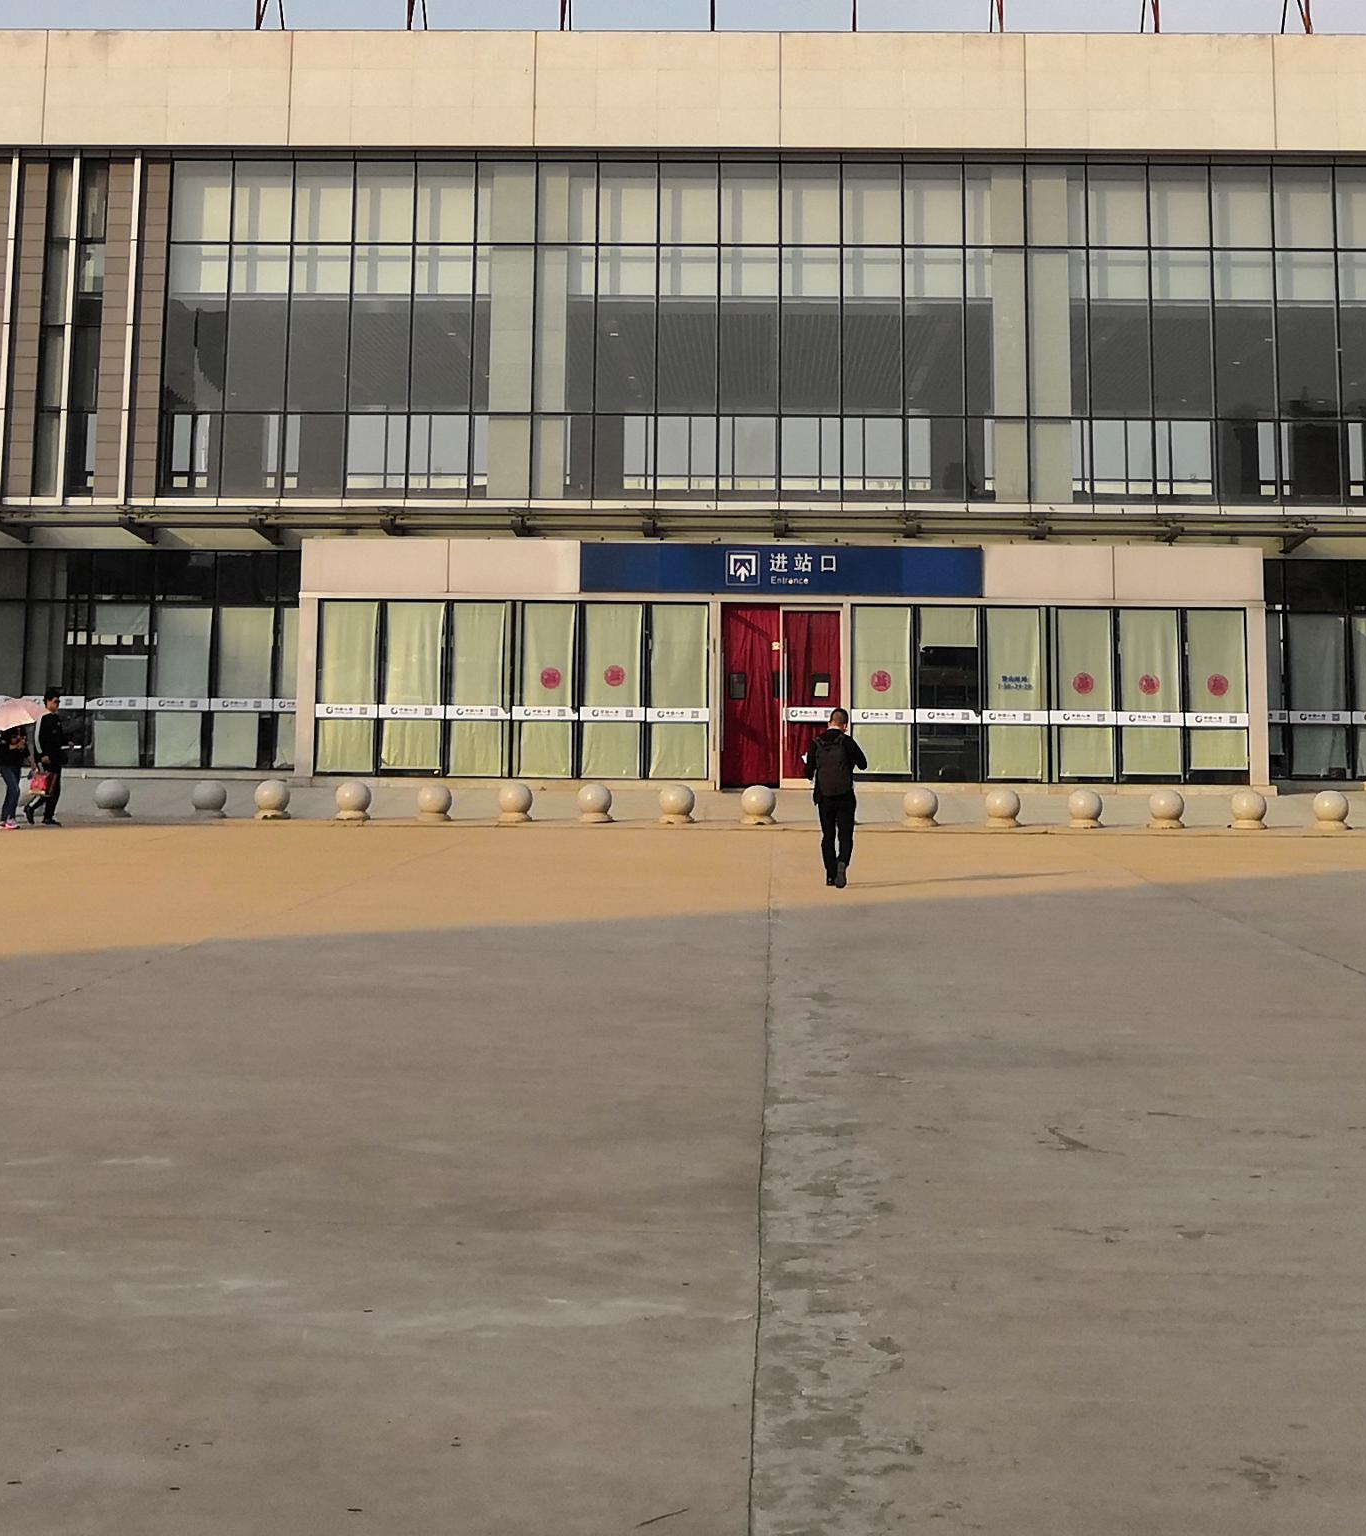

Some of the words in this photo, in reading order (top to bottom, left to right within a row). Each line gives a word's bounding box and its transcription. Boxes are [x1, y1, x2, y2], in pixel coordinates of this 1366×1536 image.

[770, 552, 836, 572] 进站口
[770, 575, 810, 585] Entrance
